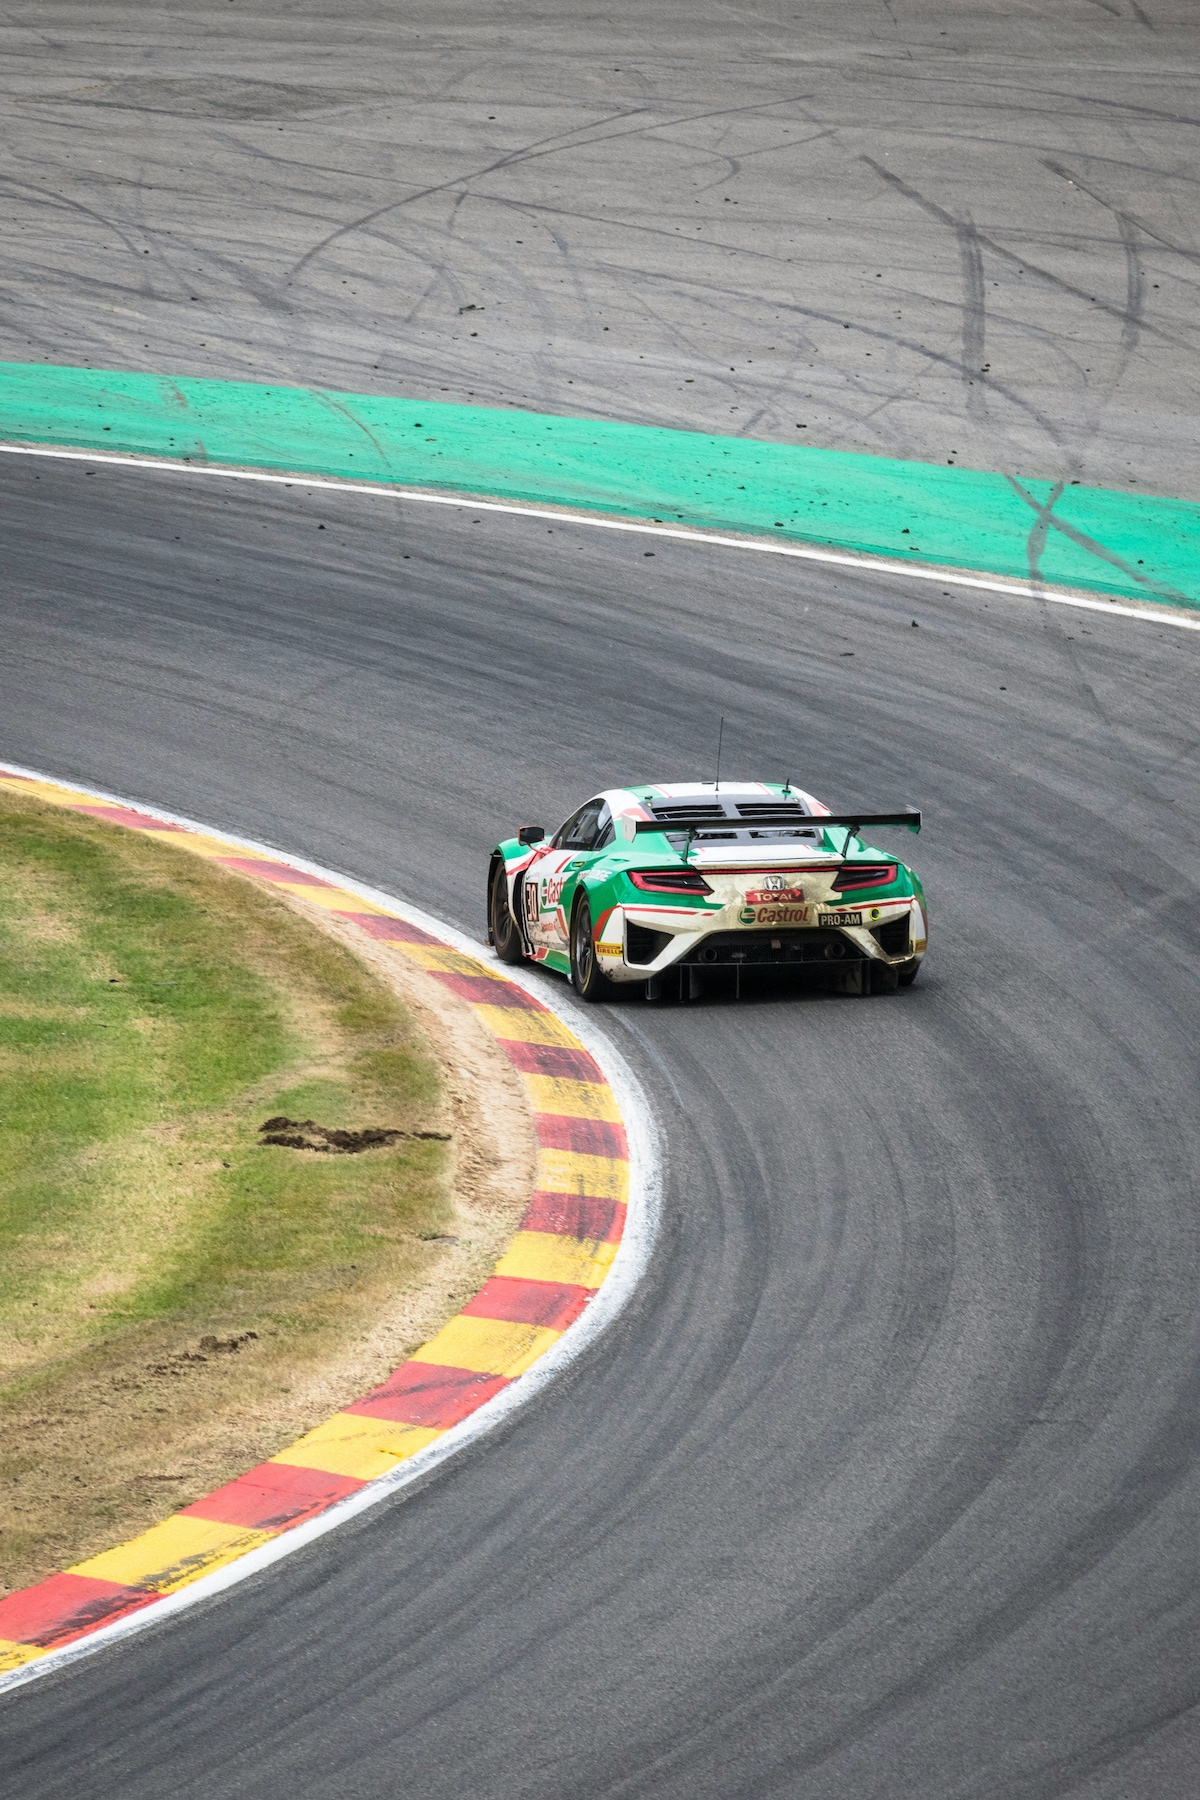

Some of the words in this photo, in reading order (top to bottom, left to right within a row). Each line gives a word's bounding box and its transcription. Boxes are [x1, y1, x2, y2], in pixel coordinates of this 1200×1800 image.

[547, 877, 566, 904] Cast
[754, 892, 794, 902] TOTAL
[526, 884, 538, 920] 30
[757, 906, 809, 923] Castrol
[820, 913, 861, 926] PRO-AM
